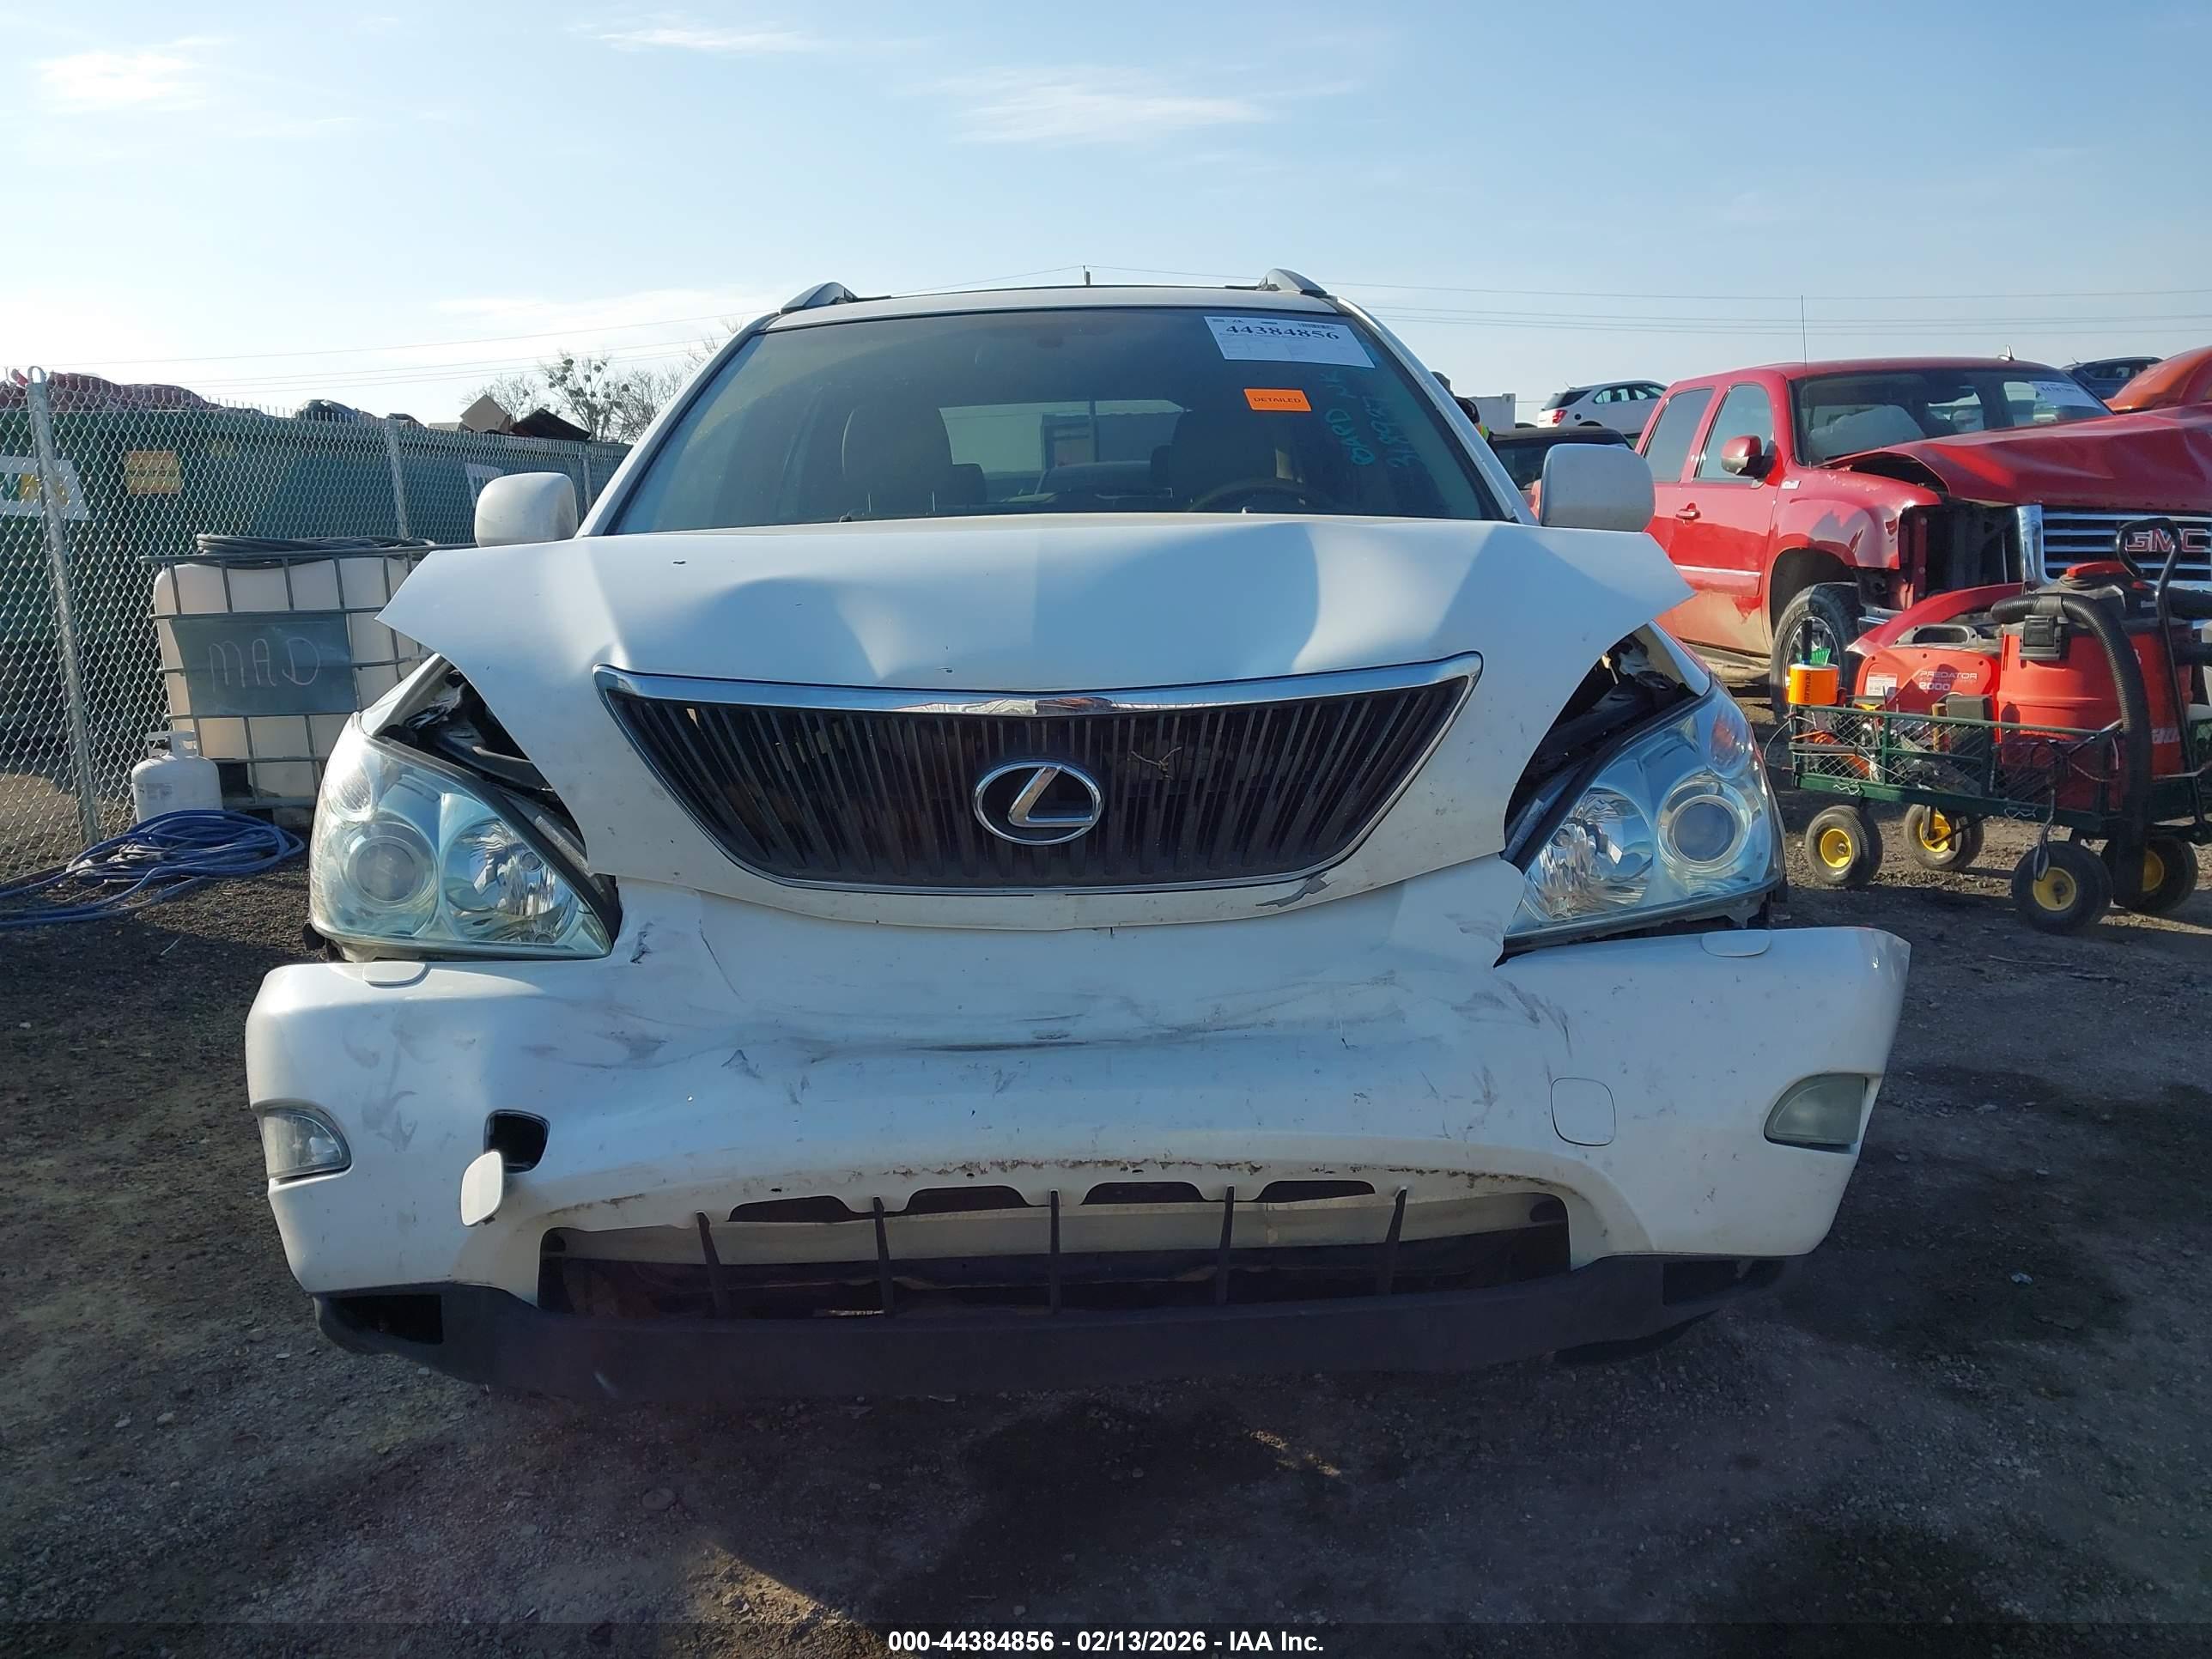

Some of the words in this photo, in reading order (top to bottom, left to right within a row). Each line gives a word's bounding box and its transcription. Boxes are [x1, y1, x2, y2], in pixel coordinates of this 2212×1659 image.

[1225, 325, 1340, 340] 44384856
[2124, 528, 2211, 552] GMC
[208, 637, 320, 692] MAD
[1919, 671, 1978, 680] PREDATOR
